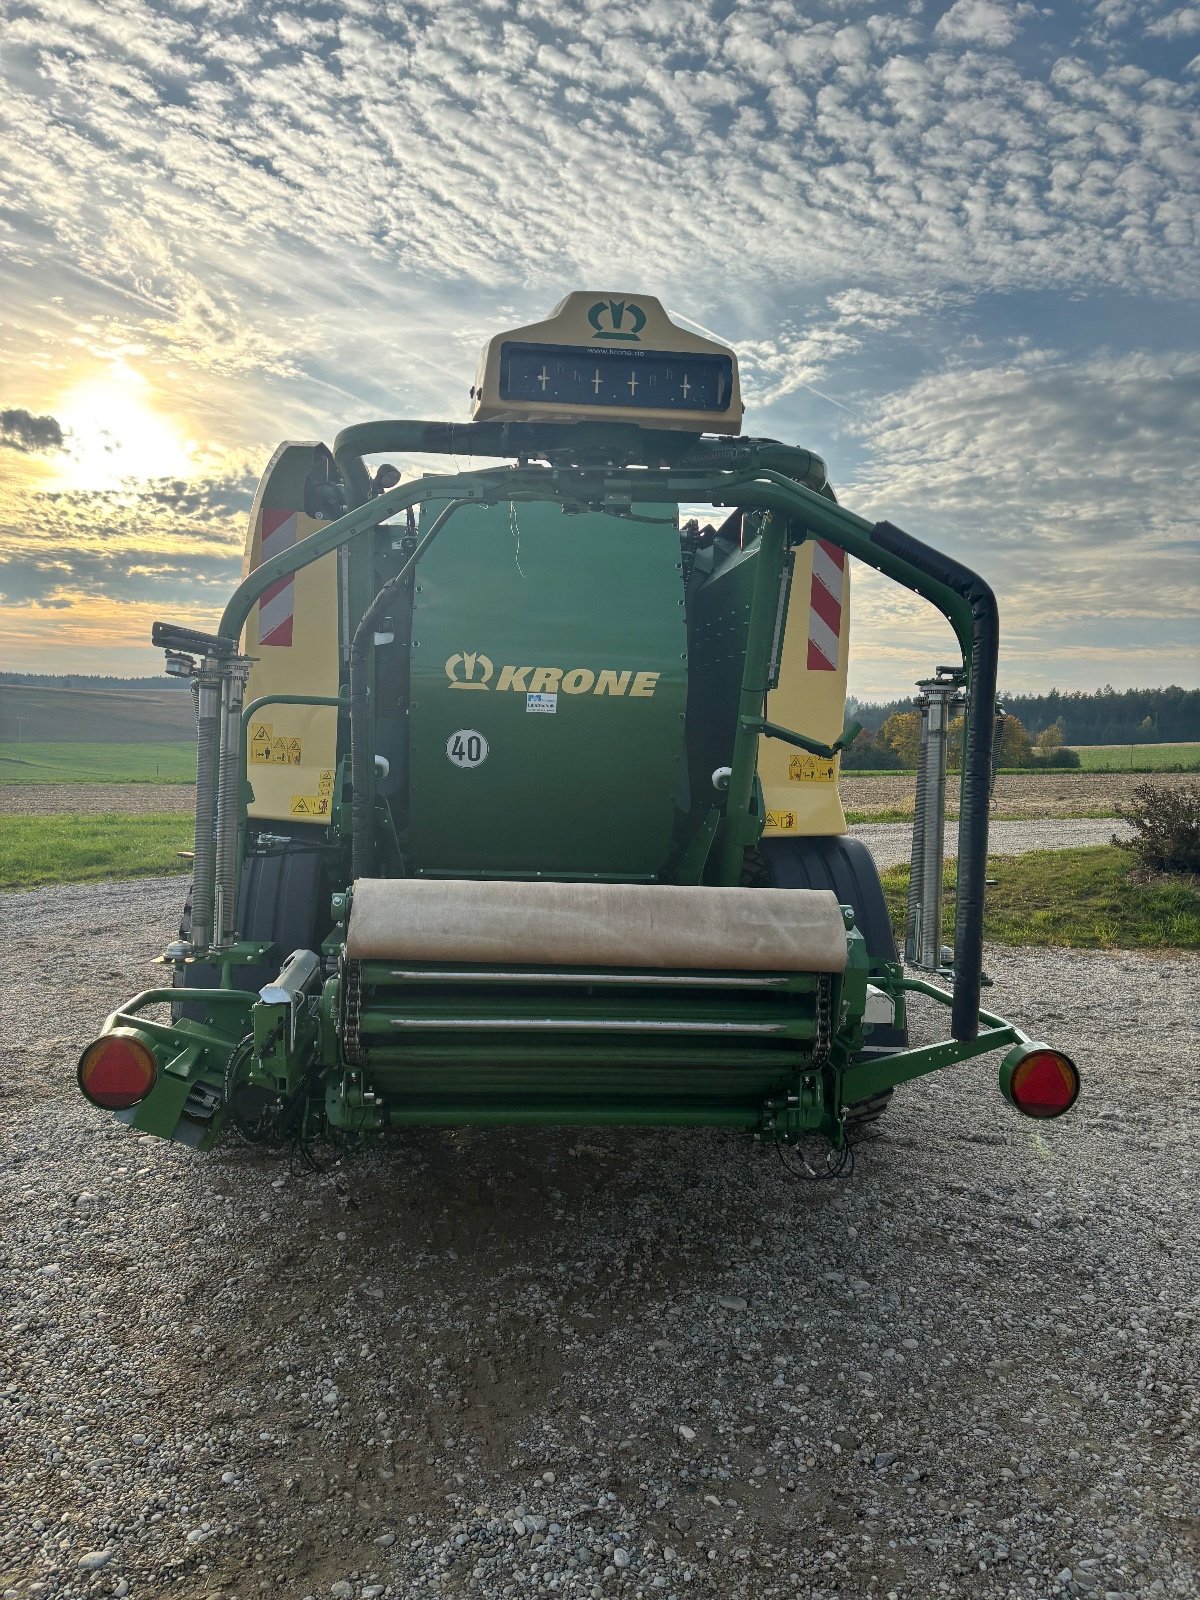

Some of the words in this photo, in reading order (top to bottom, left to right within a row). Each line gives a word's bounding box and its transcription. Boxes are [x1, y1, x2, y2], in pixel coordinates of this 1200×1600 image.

[587, 348, 645, 357] www.krone.de
[495, 665, 661, 697] KRONE
[451, 735, 481, 761] 40
